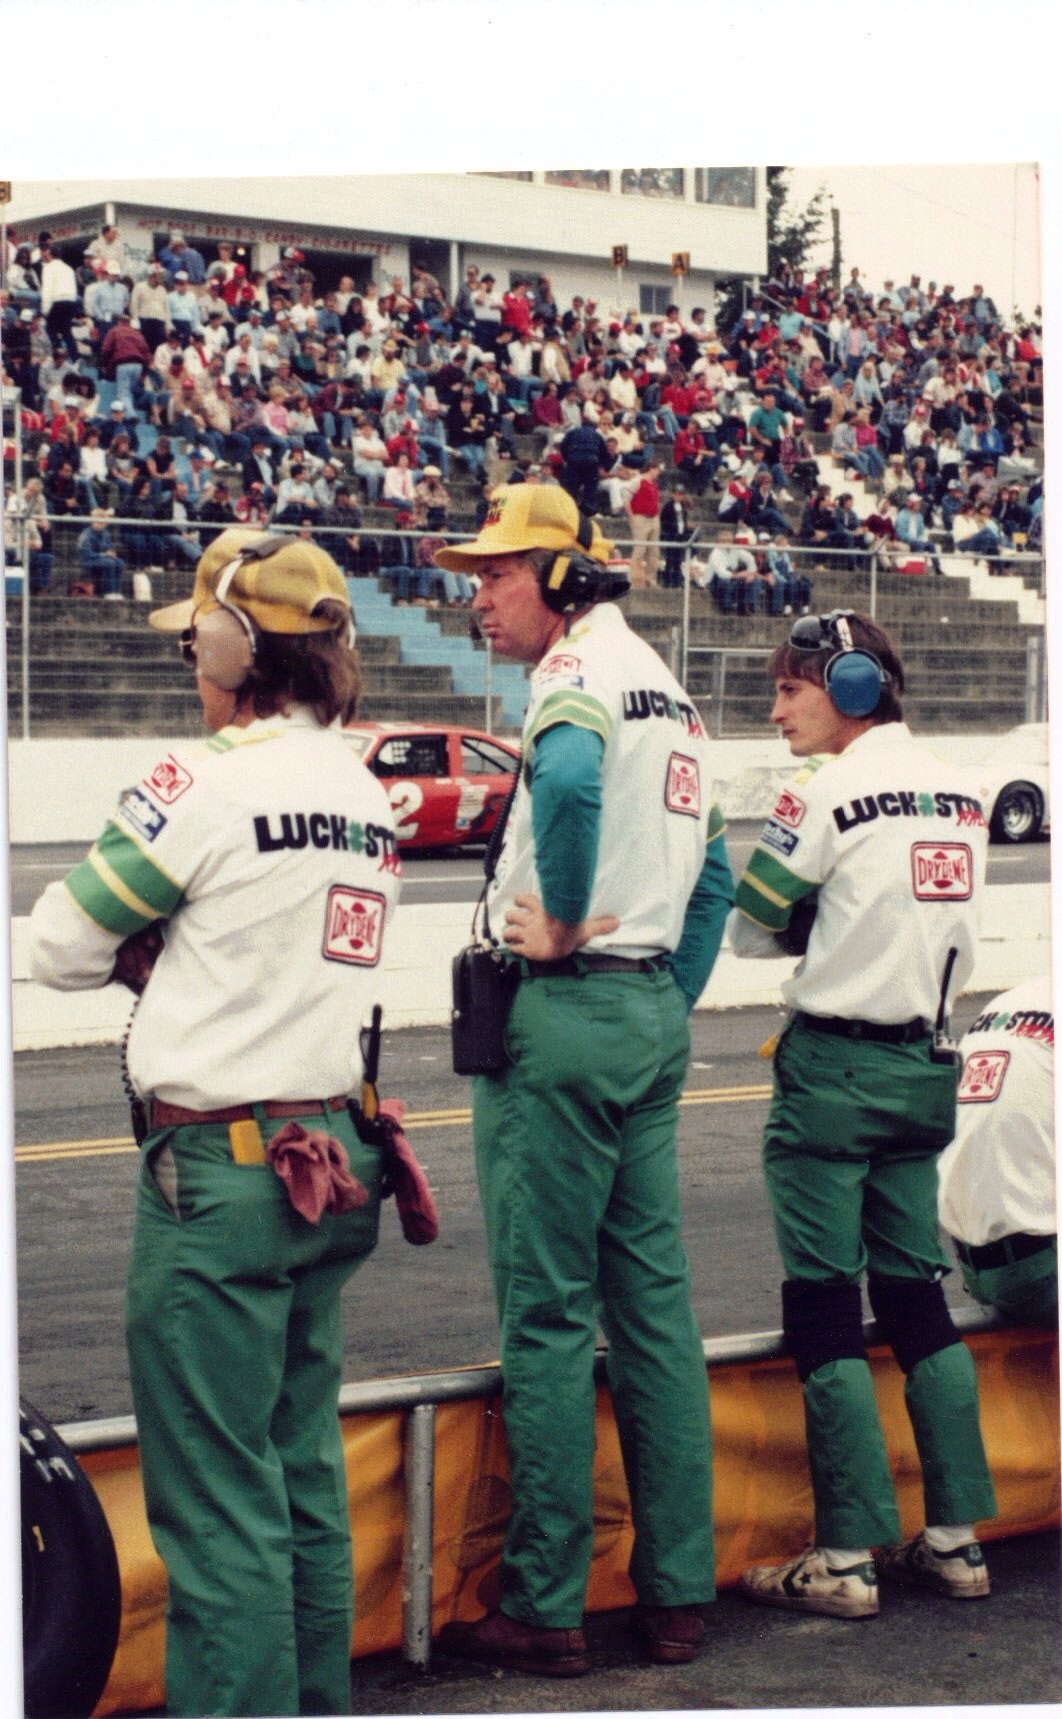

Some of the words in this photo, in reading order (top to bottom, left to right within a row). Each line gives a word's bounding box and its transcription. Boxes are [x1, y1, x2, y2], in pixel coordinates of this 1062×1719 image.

[253, 812, 349, 852] LUCK
[832, 791, 918, 834] LUCK
[917, 855, 967, 886] DRYDENE
